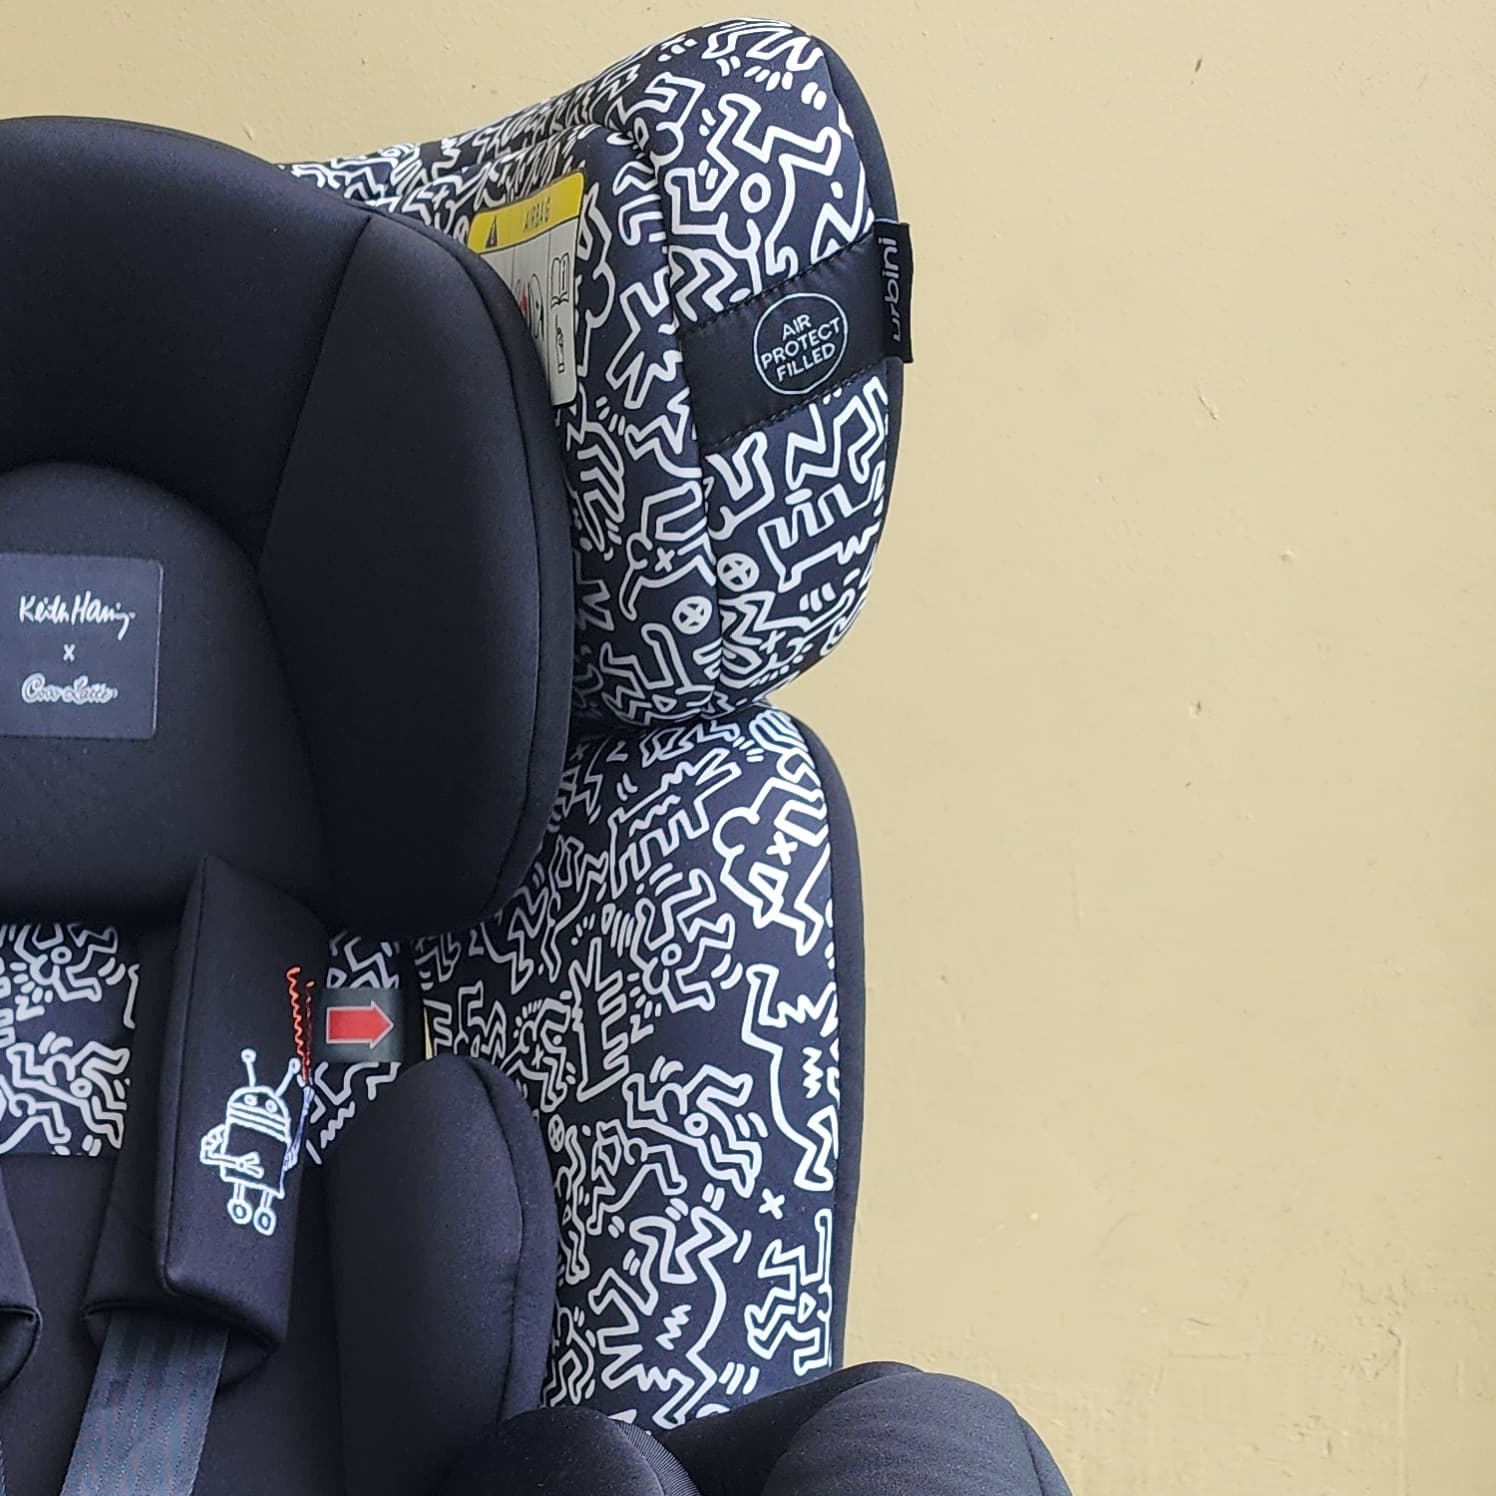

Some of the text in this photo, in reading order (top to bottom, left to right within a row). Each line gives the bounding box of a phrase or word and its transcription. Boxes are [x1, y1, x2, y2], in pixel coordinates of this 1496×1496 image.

[523, 196, 551, 232] AIRBAG
[761, 317, 841, 369] PROTECT
[782, 314, 812, 341] AIR
[776, 342, 836, 382] FILLED
